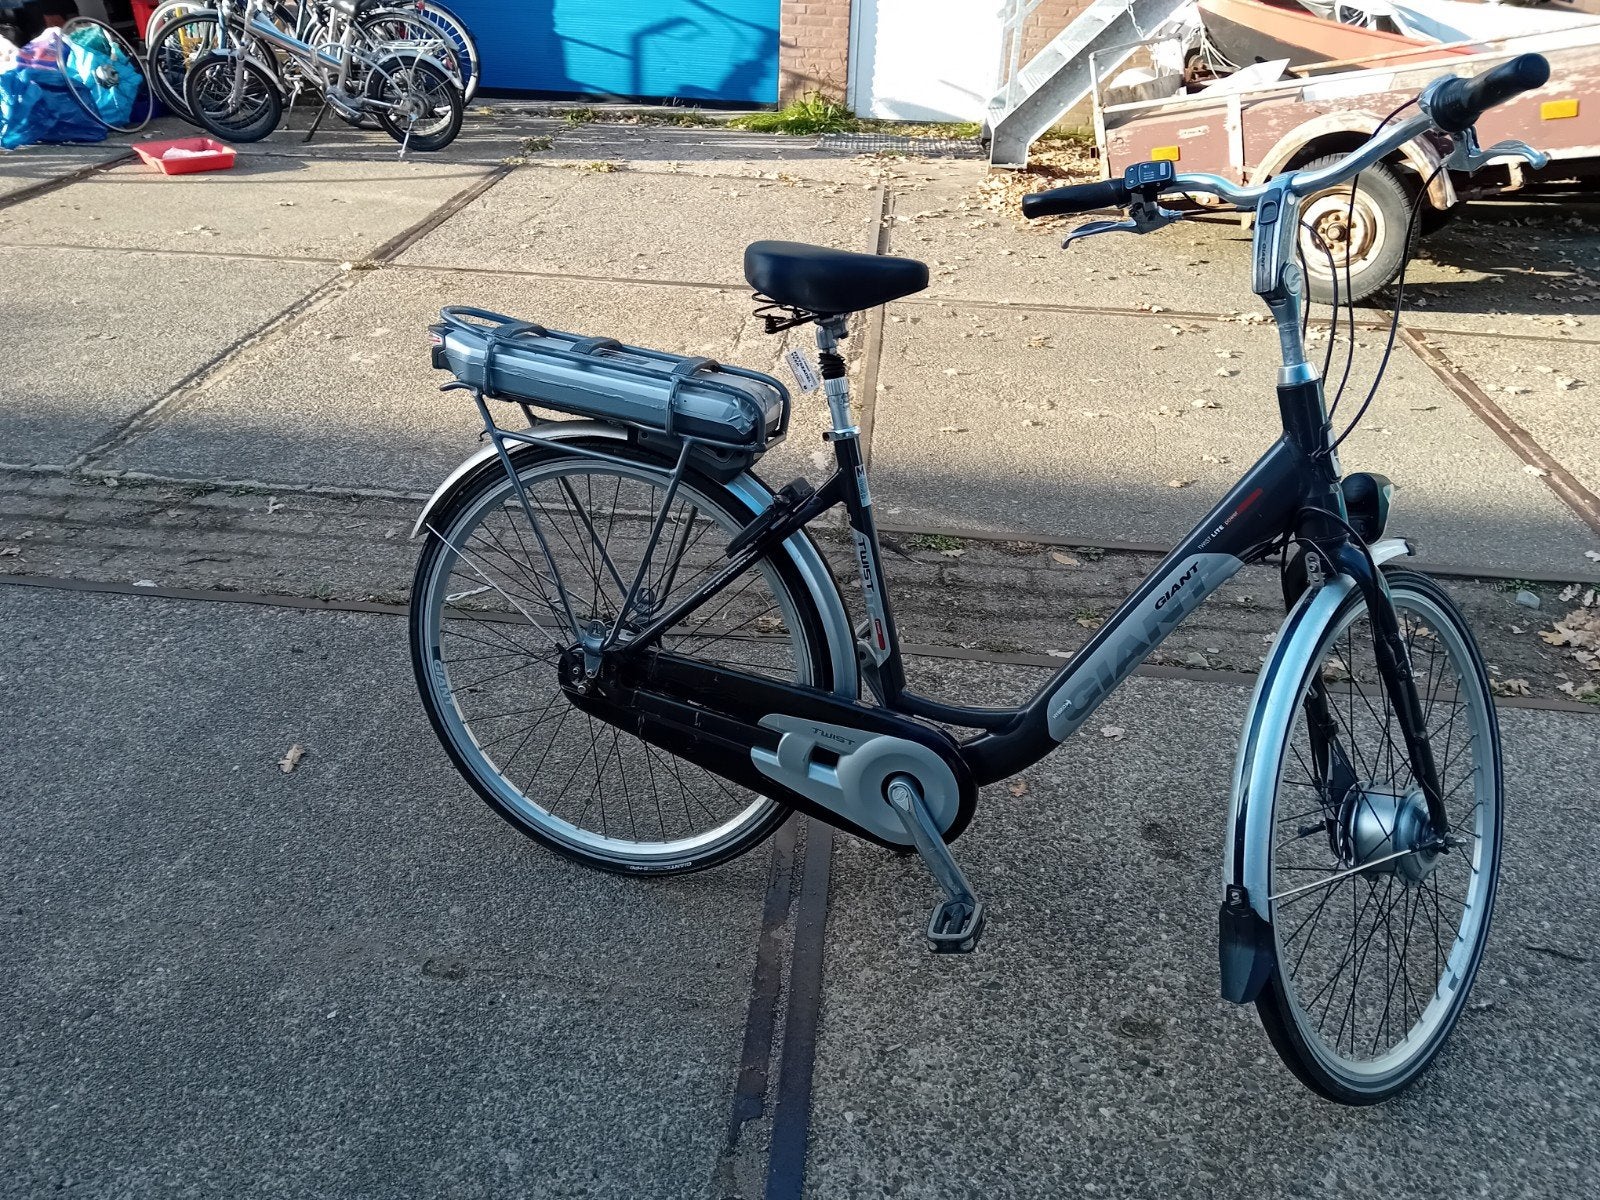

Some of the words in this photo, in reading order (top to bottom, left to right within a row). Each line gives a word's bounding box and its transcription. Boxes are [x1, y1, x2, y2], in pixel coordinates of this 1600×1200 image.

[855, 465, 865, 478] M
[1197, 536, 1212, 550] TWIST
[1210, 524, 1225, 538] LITE
[858, 538, 875, 592] TWIST
[1154, 561, 1199, 610] GIANT
[1065, 557, 1209, 722] GIANT
[433, 659, 453, 706] GIANT
[812, 726, 856, 746] TWIST
